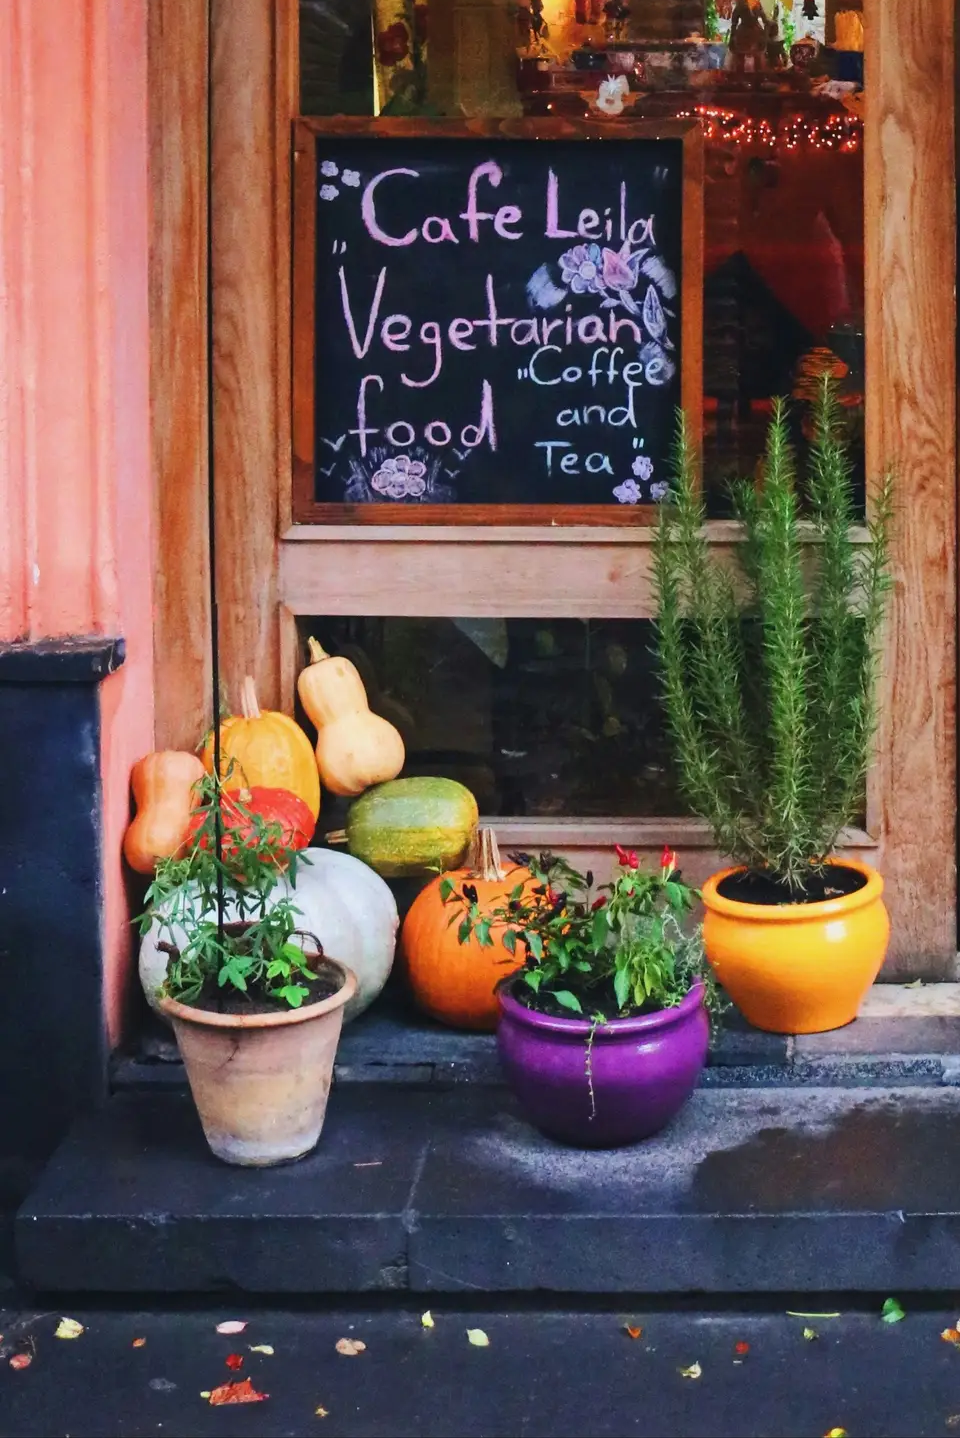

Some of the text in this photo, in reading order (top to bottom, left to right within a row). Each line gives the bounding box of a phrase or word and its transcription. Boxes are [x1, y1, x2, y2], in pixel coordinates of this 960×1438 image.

[338, 265, 642, 388] Vegetarian
[348, 374, 499, 457] food
[556, 384, 638, 429] and
